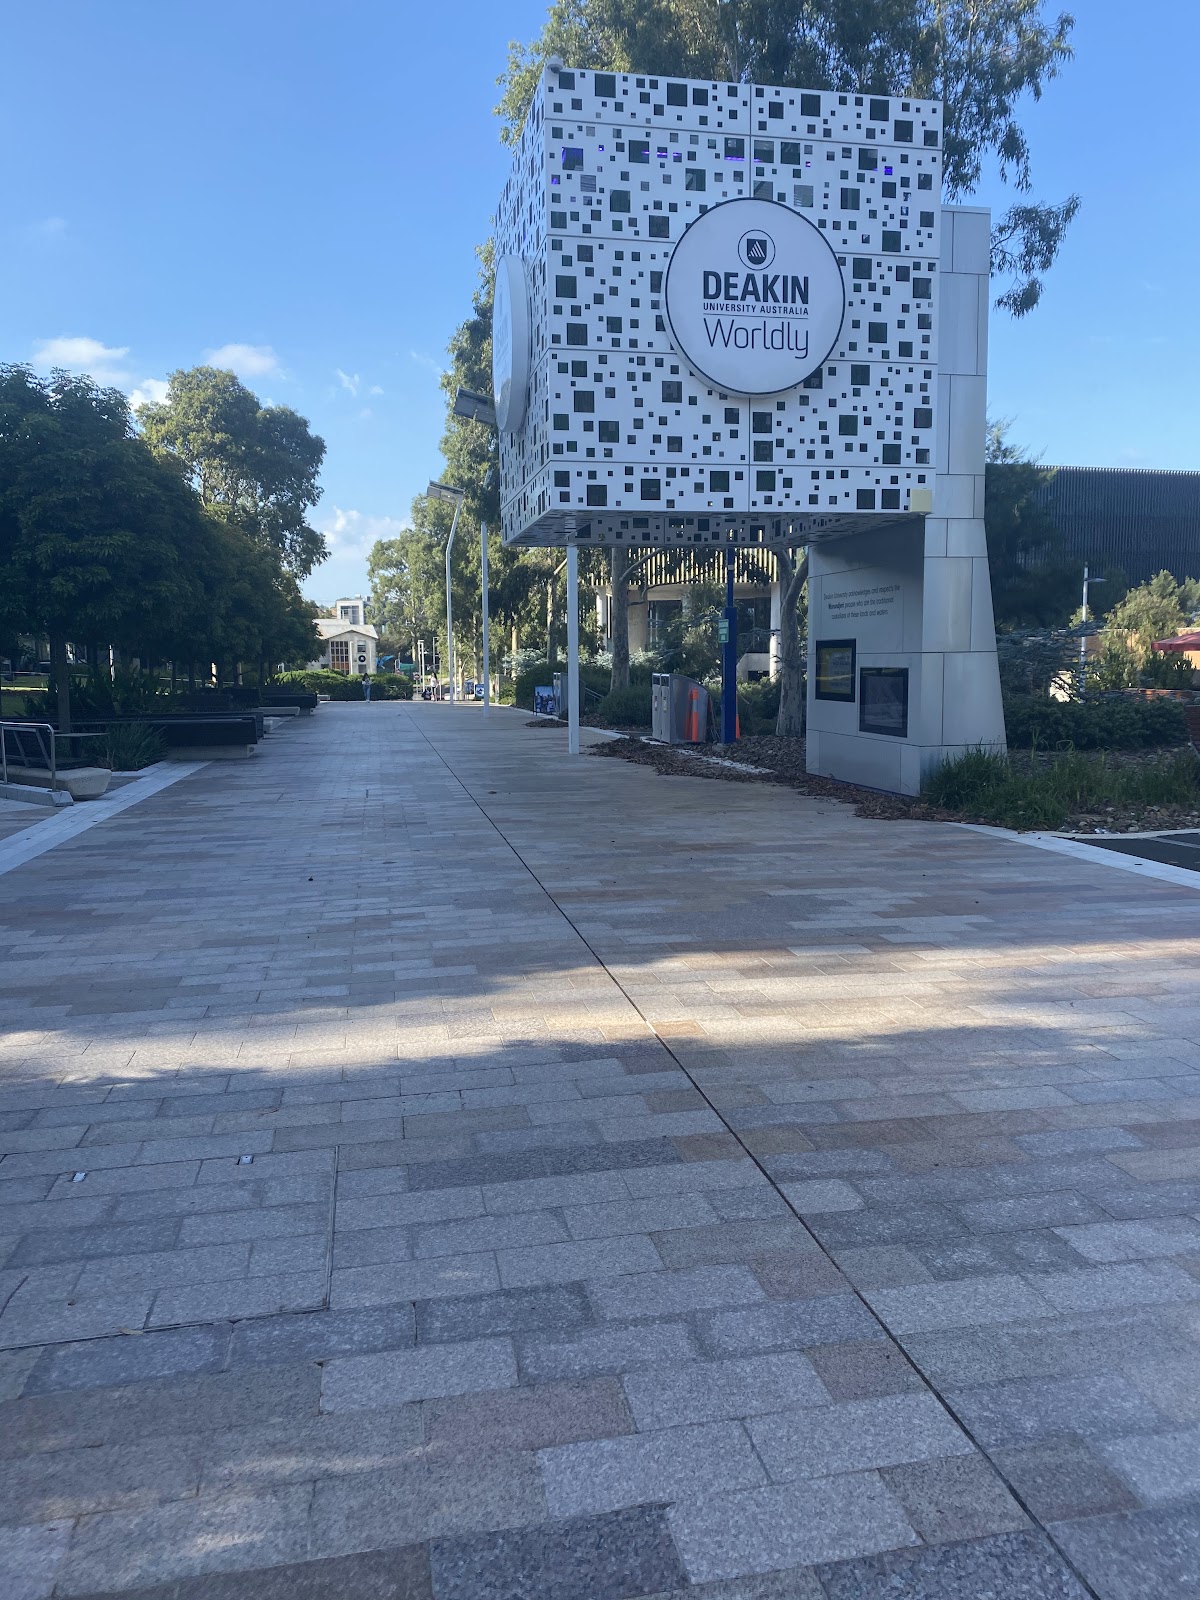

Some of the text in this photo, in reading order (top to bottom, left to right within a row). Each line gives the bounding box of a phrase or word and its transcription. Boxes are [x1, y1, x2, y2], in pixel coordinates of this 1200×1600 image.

[703, 270, 809, 304] DEAKIN
[703, 302, 809, 315] UNIVERSITY AUSTRALIA
[703, 317, 809, 360] Worldly
